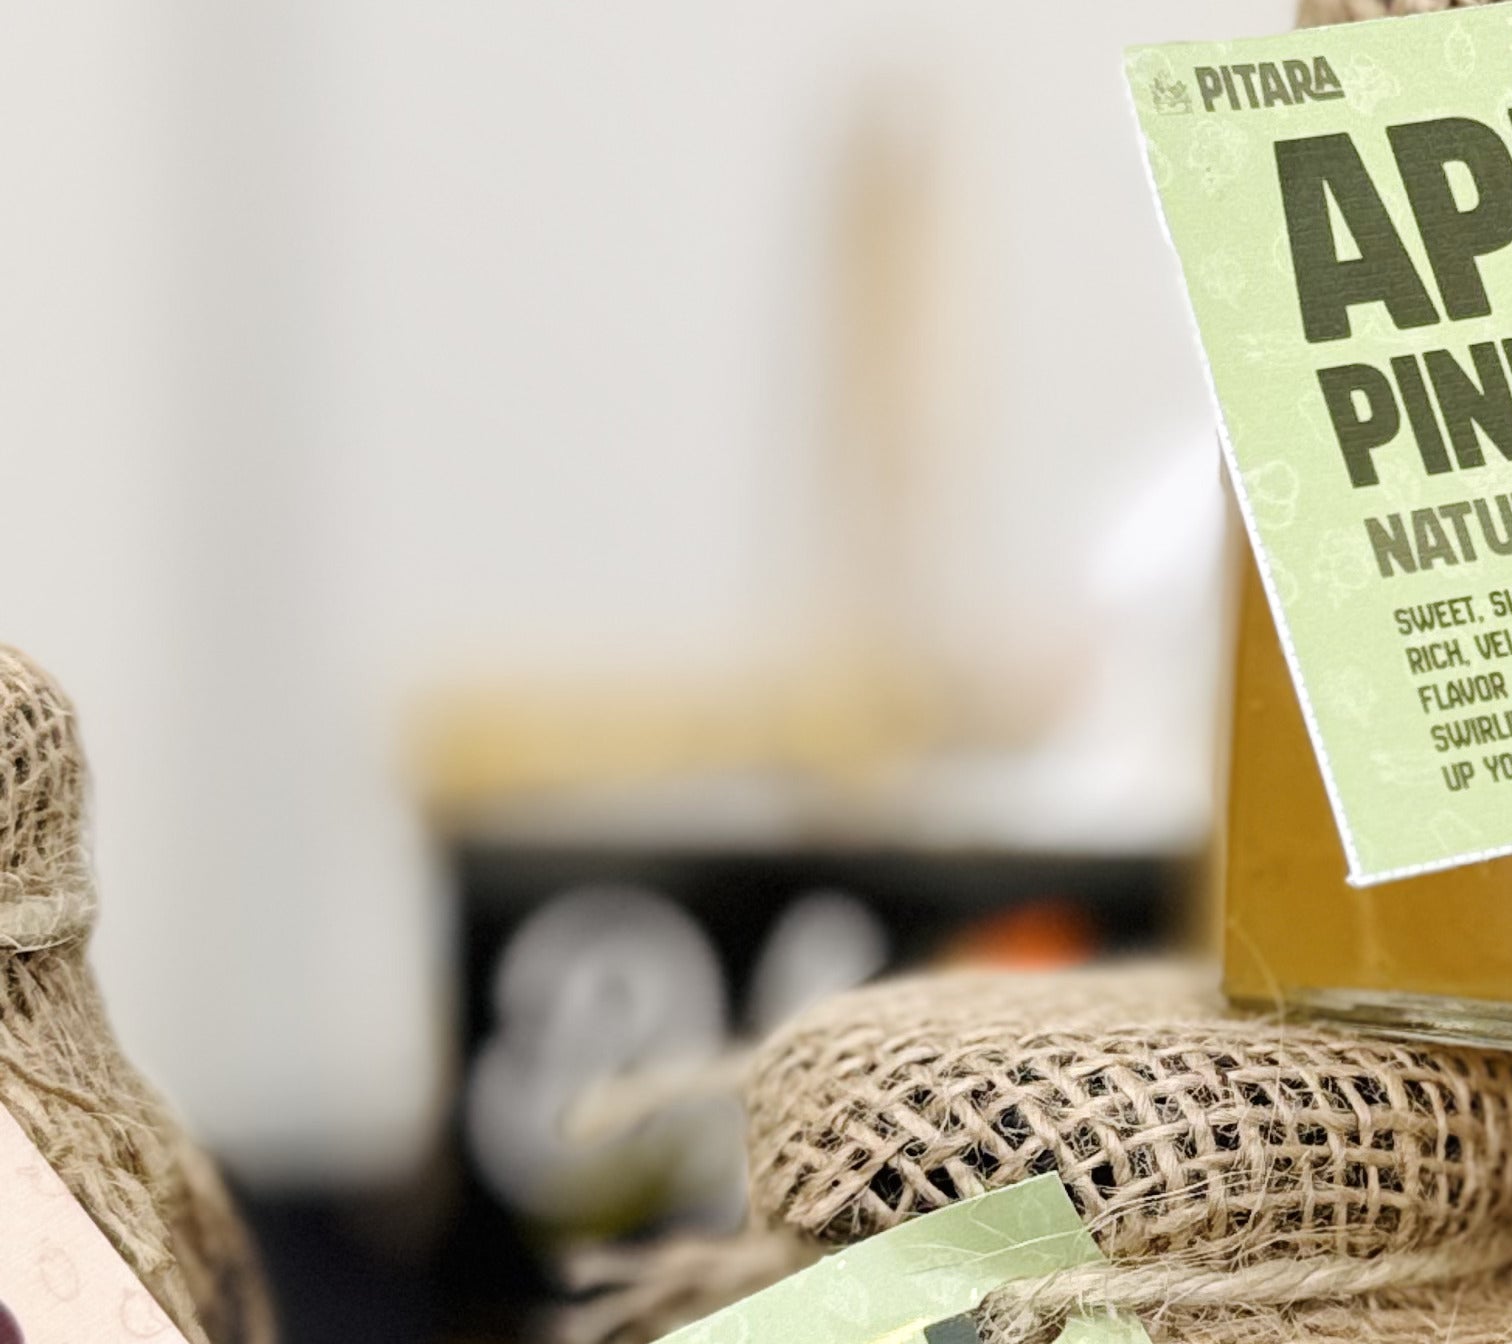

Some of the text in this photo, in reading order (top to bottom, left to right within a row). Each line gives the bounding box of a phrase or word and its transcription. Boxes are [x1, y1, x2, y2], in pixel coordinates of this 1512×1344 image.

[1193, 55, 1346, 113] PITARA
[1393, 595, 1485, 636] SWEET,
[1405, 638, 1471, 675] RICH,
[1417, 671, 1509, 714] FLAVOR
[1441, 760, 1475, 792] UP
